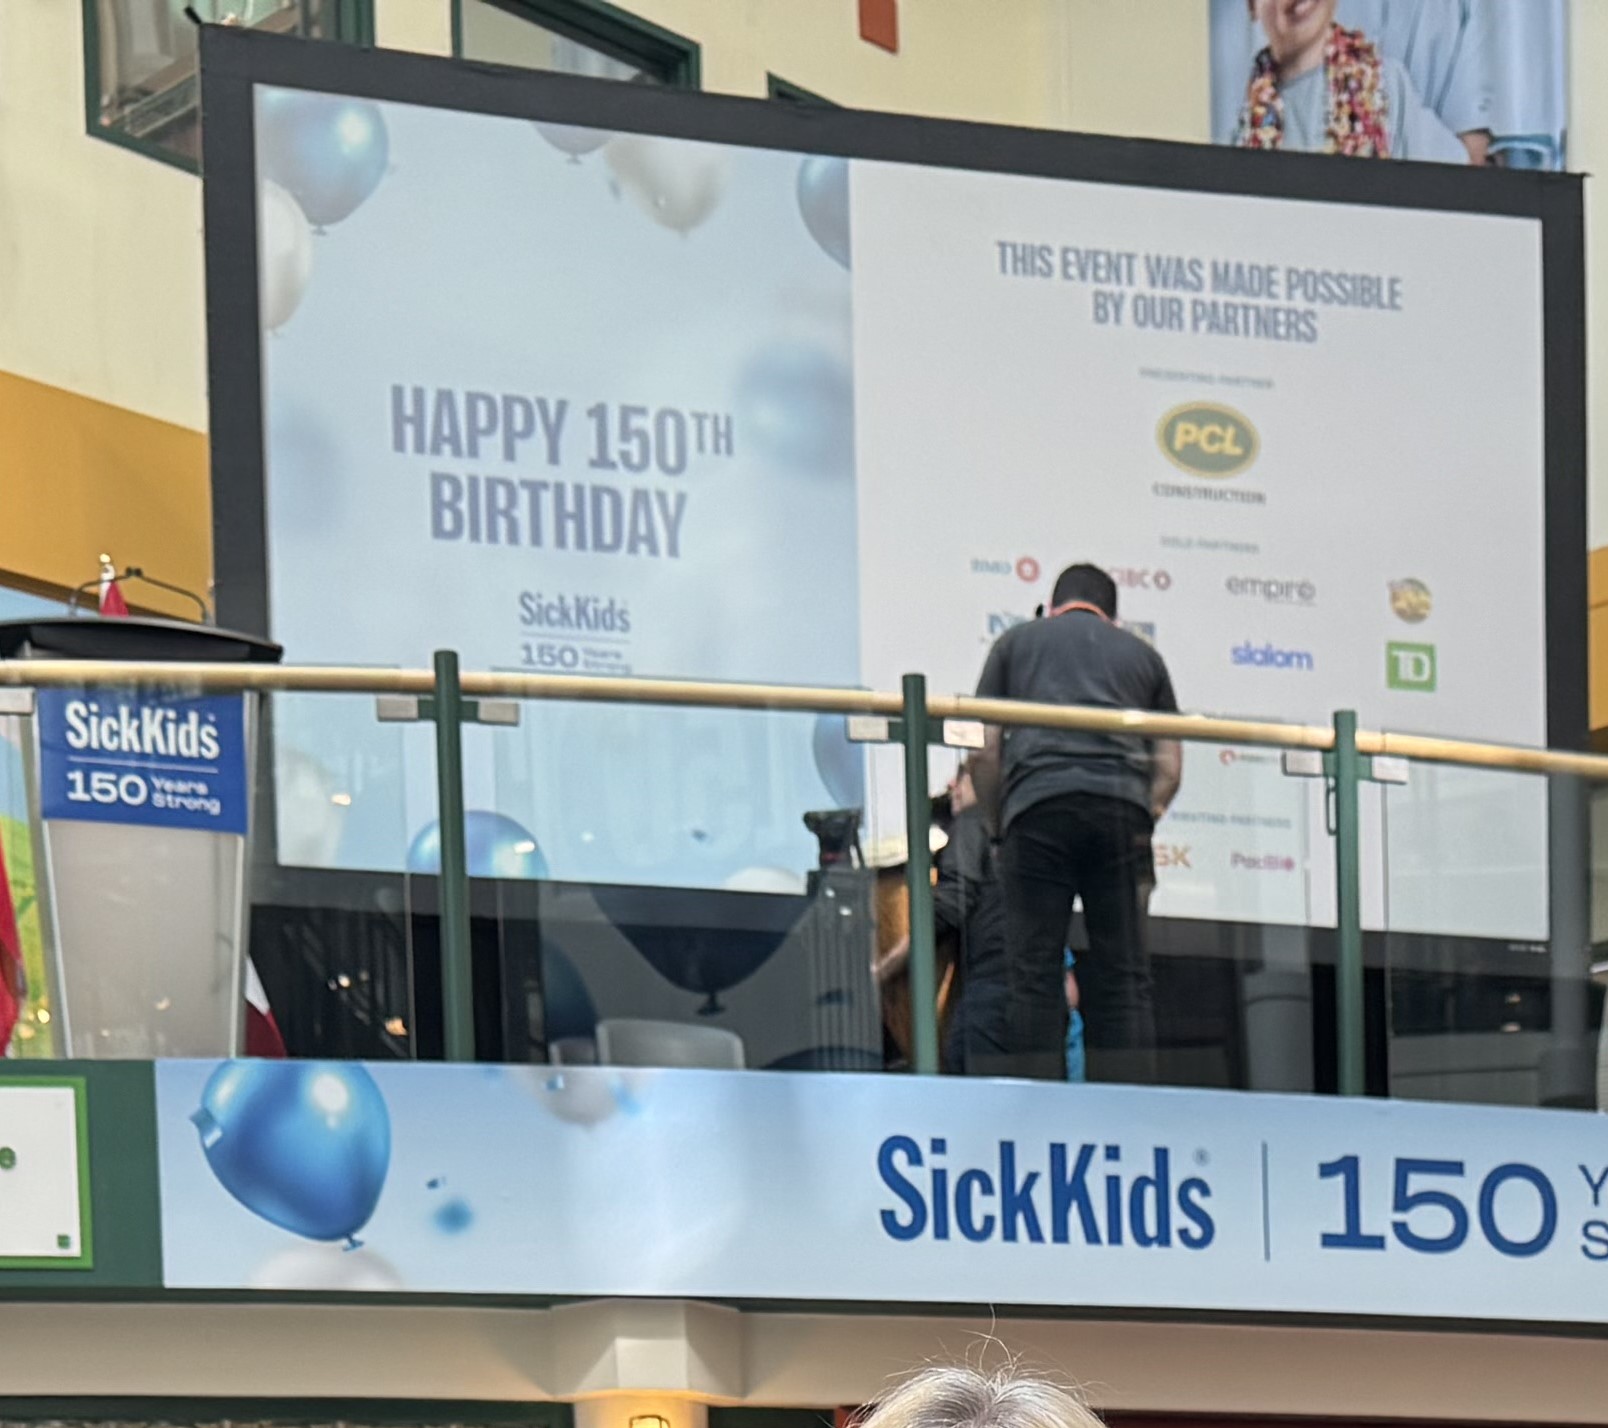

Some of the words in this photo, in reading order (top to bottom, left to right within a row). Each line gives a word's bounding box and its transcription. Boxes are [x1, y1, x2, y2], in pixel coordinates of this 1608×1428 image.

[996, 241, 1053, 278] THIS
[1061, 246, 1137, 287] EVENT
[1144, 253, 1204, 292] WAS
[1211, 260, 1279, 300] MADE
[1286, 267, 1402, 311] POSSIBLE
[1092, 290, 1125, 325] BY
[1133, 296, 1183, 330] OUR
[1192, 299, 1319, 344] PARTNERS
[391, 384, 568, 466] HAPPY
[1174, 421, 1244, 456] PCL
[430, 471, 687, 559] BIRTHDAY
[518, 591, 632, 634] SickKids
[521, 643, 579, 668] 150
[1231, 641, 1314, 671] slalom
[1389, 646, 1434, 685] TD
[64, 700, 221, 760] SickKids
[66, 769, 148, 806] 150
[151, 776, 209, 796] Years
[151, 794, 221, 816] Strong
[877, 1134, 1216, 1250] SickKids
[1318, 1155, 1558, 1257] 150
